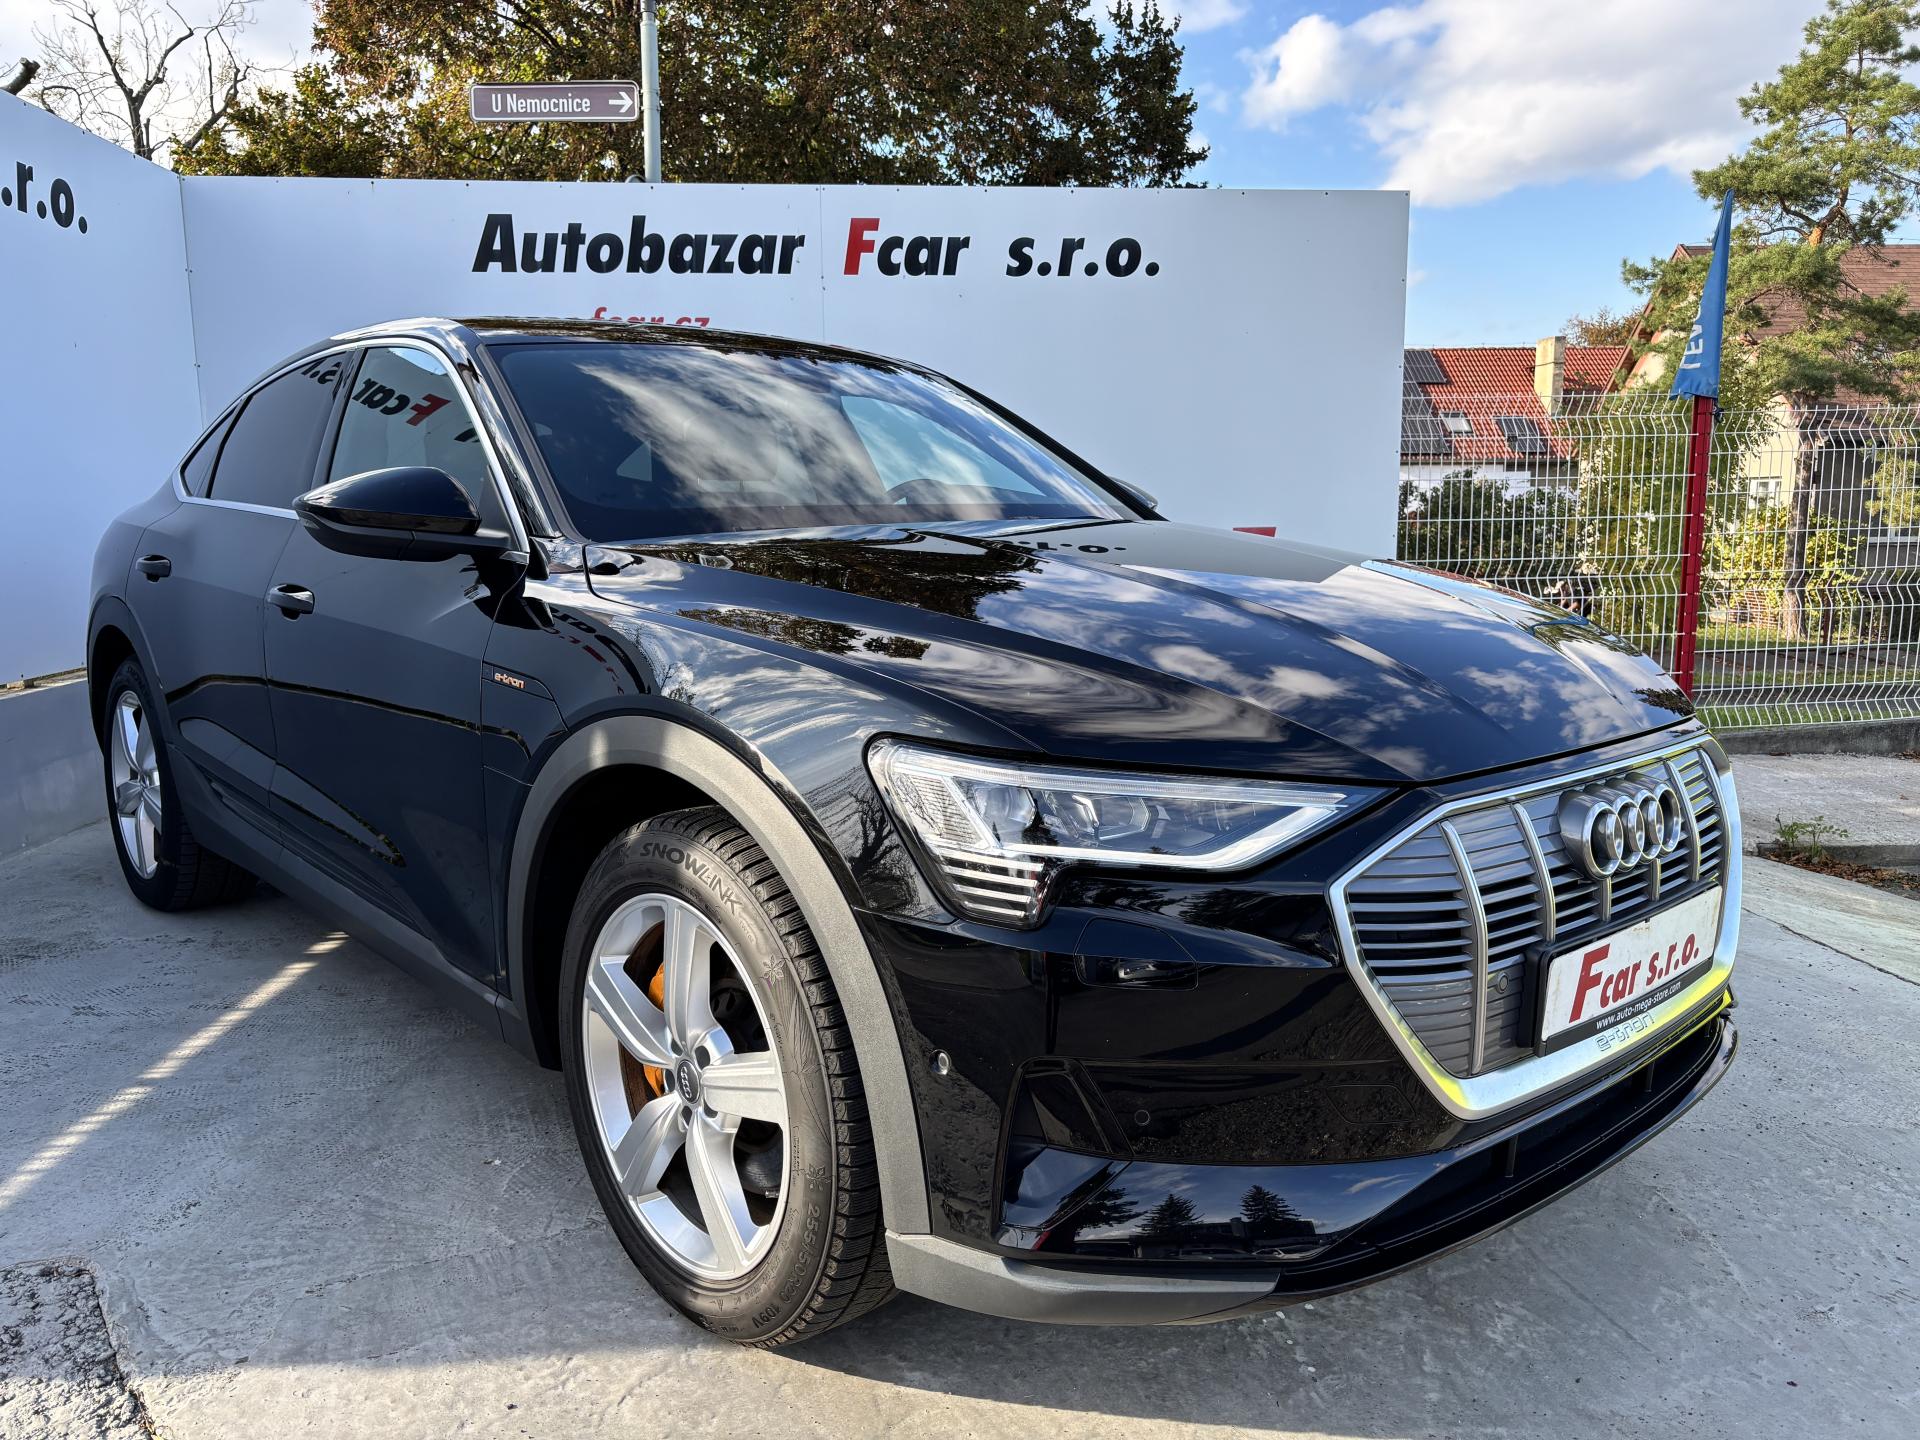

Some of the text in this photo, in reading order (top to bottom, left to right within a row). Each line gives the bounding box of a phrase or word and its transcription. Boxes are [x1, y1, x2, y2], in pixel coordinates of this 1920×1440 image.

[491, 92, 591, 113] U Nemocnice
[472, 212, 1161, 278] Autobazar Fcar s.r.o.
[640, 842, 742, 916] SNOWLINK
[1569, 933, 1700, 1024] Fcar s.r.o.
[1595, 981, 1682, 1031] www.auto-mega-store.com
